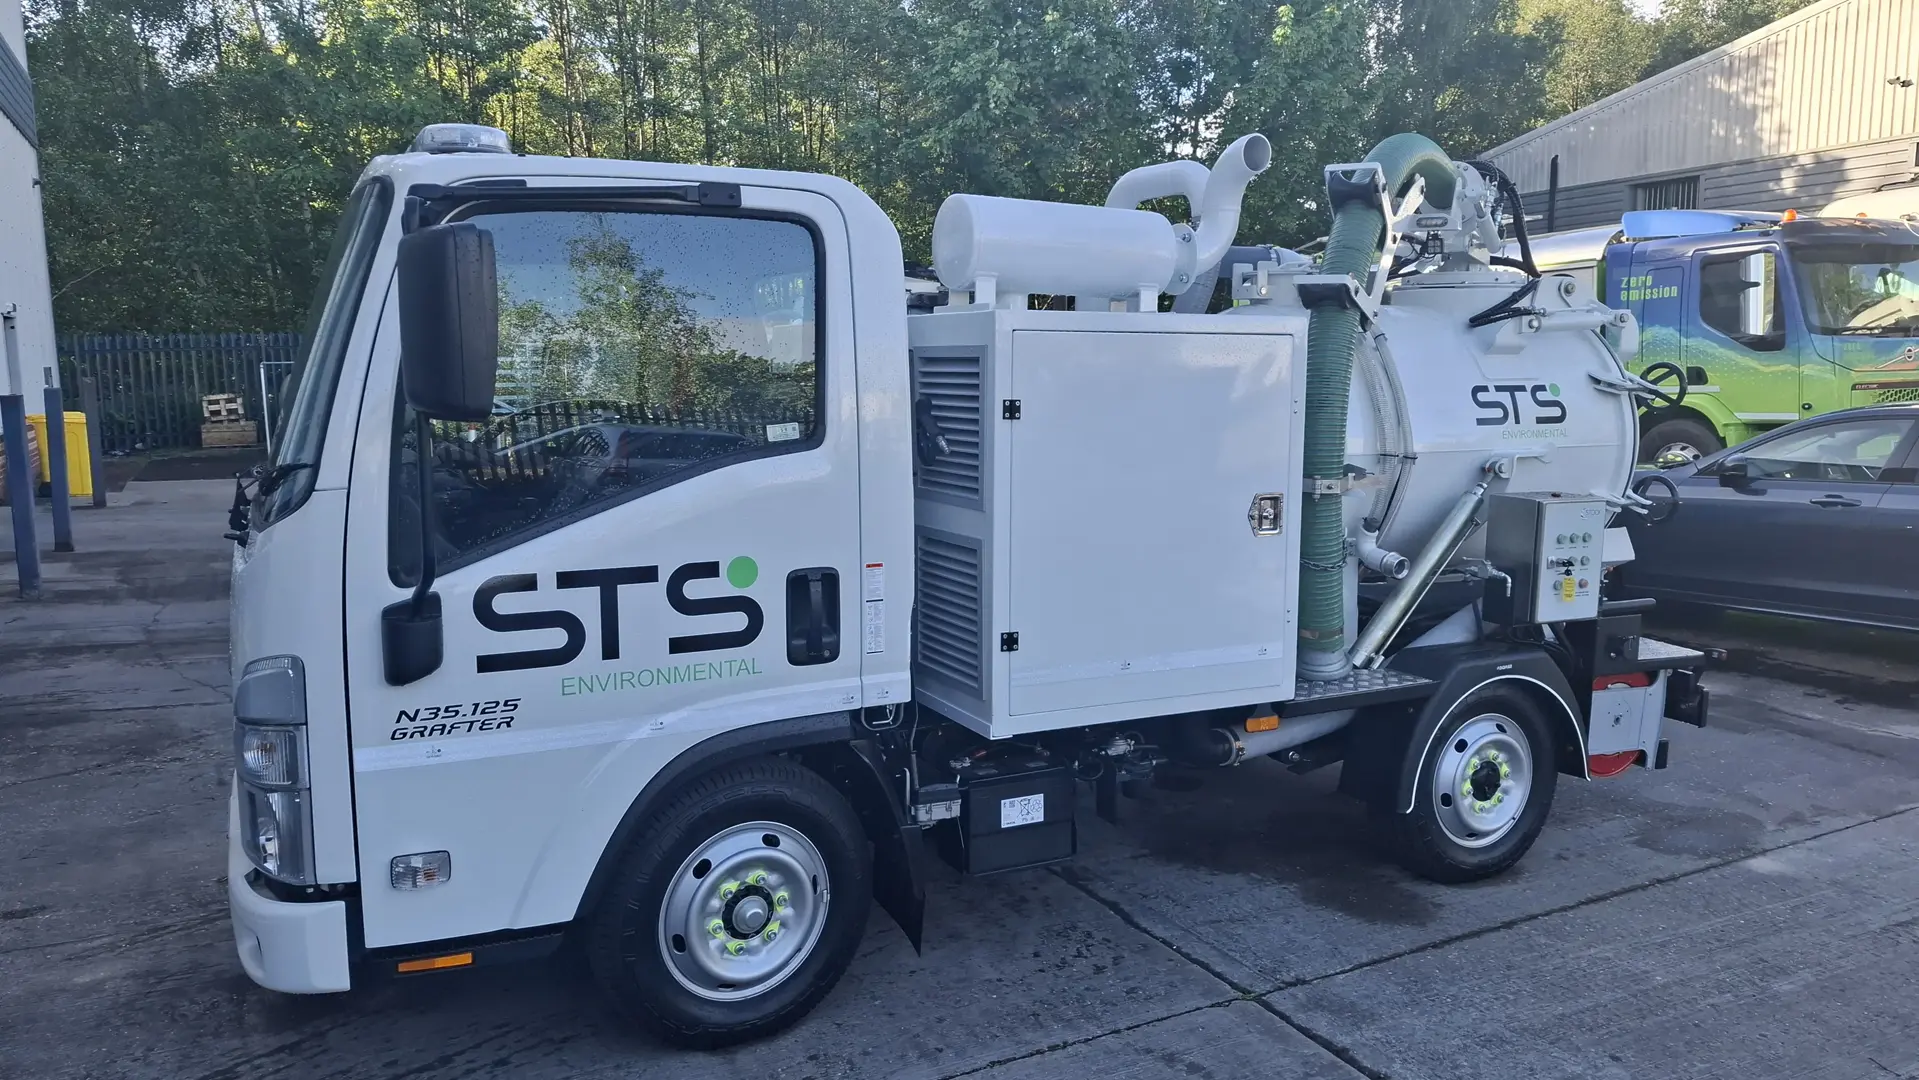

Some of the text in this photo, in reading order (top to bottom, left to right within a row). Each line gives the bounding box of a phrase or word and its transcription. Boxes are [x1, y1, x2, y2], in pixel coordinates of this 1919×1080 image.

[1620, 284, 1678, 301] emission
[1471, 384, 1567, 426] STS
[1502, 428, 1568, 440] ENVIRONMENTAL
[472, 560, 764, 674] STS
[561, 657, 762, 697] ENVIRONMENTAL
[395, 698, 521, 724] N35.125
[390, 716, 515, 740] GRAFTER
